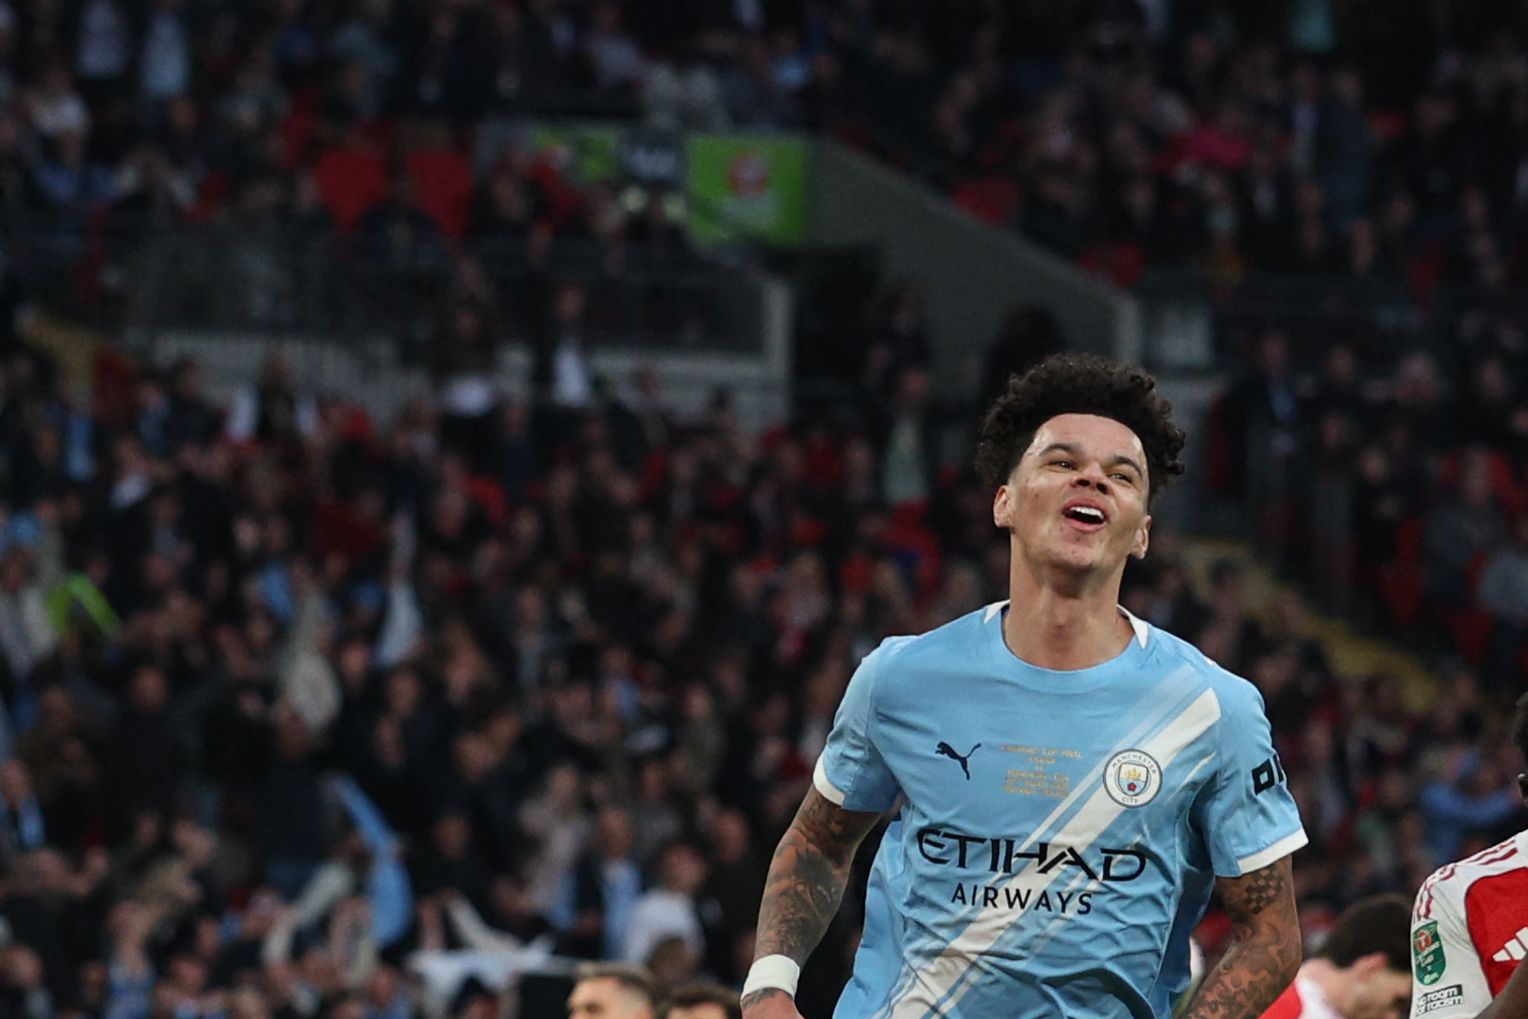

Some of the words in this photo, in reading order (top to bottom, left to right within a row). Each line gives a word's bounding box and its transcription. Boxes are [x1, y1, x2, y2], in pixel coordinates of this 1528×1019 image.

[1112, 753, 1157, 774] MANCHESTER
[1121, 796, 1139, 805] CITY
[917, 827, 1147, 882] ETIHAD
[950, 882, 1093, 915] AIRWAYS
